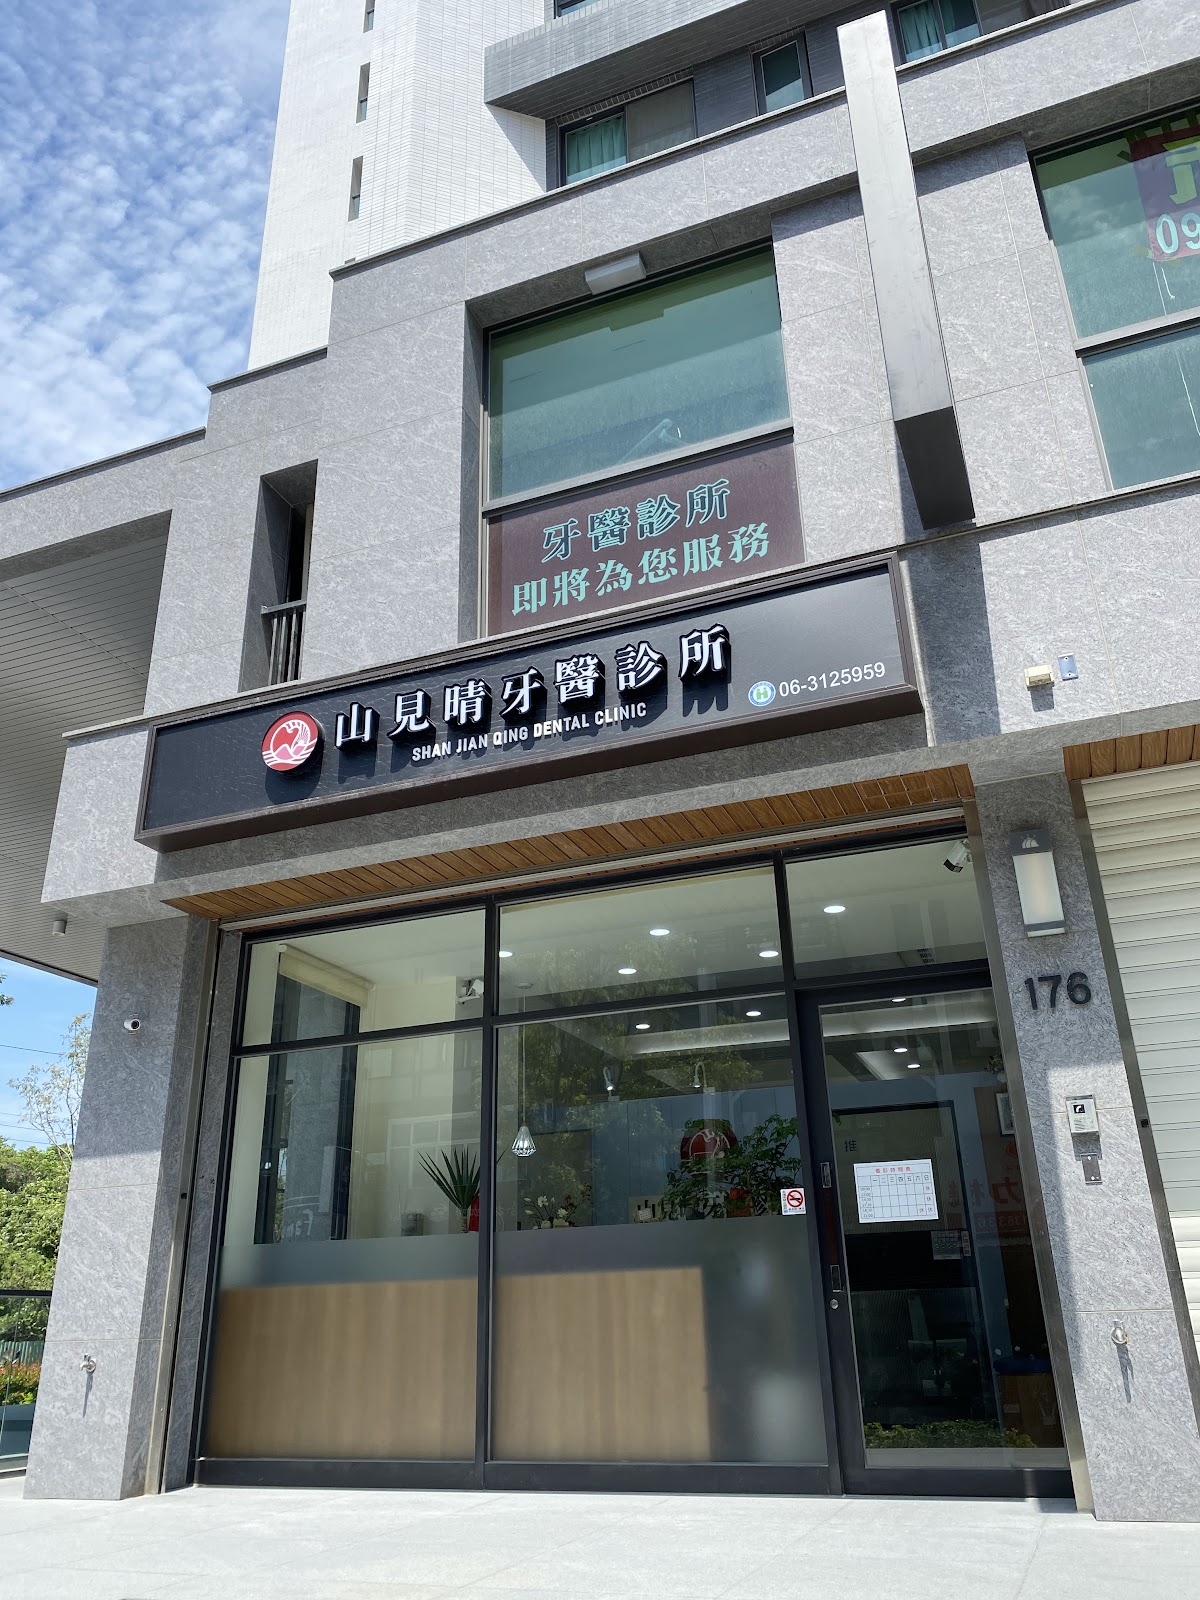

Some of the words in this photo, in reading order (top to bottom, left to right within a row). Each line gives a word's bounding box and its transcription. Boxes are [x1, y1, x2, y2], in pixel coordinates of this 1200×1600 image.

[541, 478, 730, 563] 牙醫診所
[511, 522, 769, 616] 即將為您服務
[335, 624, 728, 748] 山見晴牙醫診所
[778, 662, 886, 697] 06-3125959
[412, 741, 451, 761] SHAN
[456, 734, 488, 754] JIAN
[493, 726, 529, 746] QING
[533, 713, 590, 738] DENTAL
[595, 702, 647, 726] CLINIC
[1024, 971, 1092, 1010] 176
